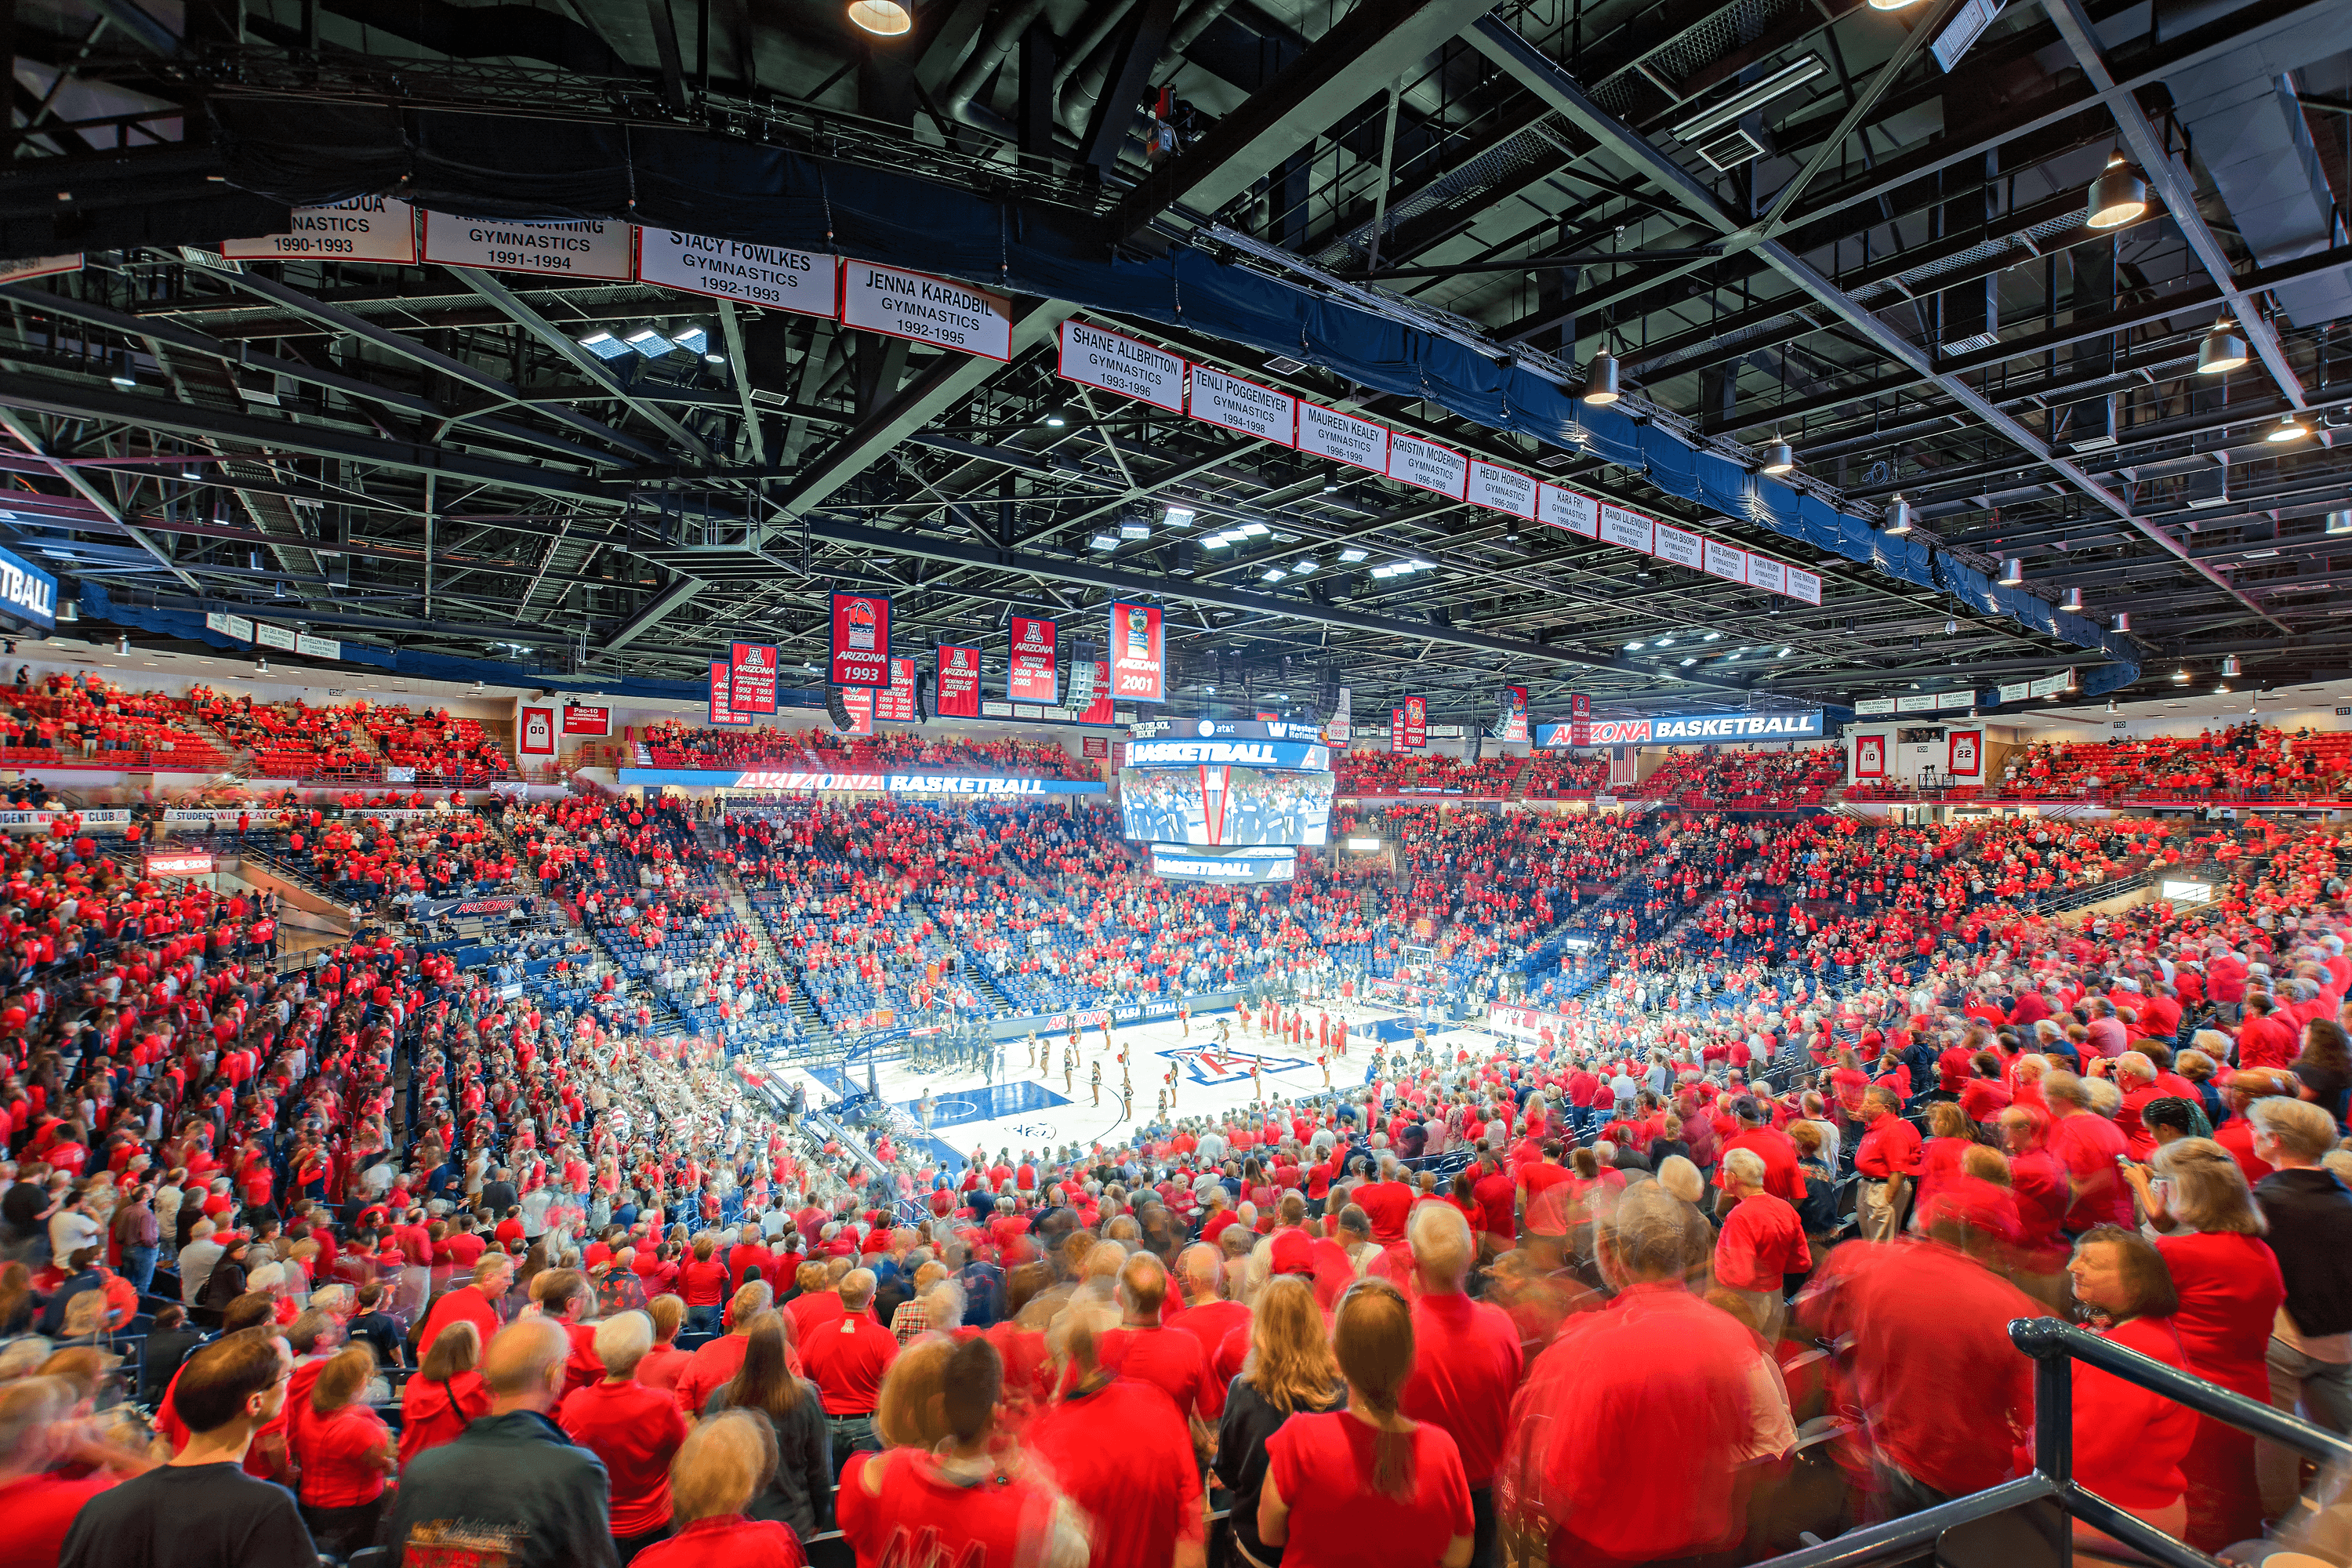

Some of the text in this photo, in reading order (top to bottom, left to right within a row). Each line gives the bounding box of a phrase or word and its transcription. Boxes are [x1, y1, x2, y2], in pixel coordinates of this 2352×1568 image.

[292, 216, 370, 233] NASTICS
[274, 238, 354, 253] 1990-1993
[469, 228, 590, 252] GYMNASTICS
[488, 250, 572, 269] 1991-1994
[731, 241, 811, 272] FOWLKES
[682, 253, 798, 288] GYMNASTICS
[700, 276, 780, 303] 1992-1993
[866, 270, 993, 318] JENNA KARADBIL
[880, 296, 980, 331] GYMNASTICS
[896, 318, 965, 345] 1992-1995
[1073, 327, 1178, 376] SHANE ALLBRITTON
[1089, 354, 1162, 386] GYMNASTICS
[1101, 372, 1151, 397] 1993-1996
[1196, 369, 1287, 413] TENLI POGGEMEYER
[1213, 395, 1275, 423] GYMNASTICS
[1222, 412, 1265, 434] 1994-1998
[1308, 408, 1380, 442] MAUREEN KEALEY
[1318, 429, 1371, 452] GYMNASTICS
[1392, 437, 1425, 457] KRISTIN
[1326, 445, 1363, 463] 1996-1999
[1408, 458, 1454, 480] GYMNASTICS
[1414, 473, 1446, 490] 1996-1999
[1479, 466, 1531, 492] HEIDI HORNBEEK
[1485, 483, 1525, 502] GYMNASTICS
[1557, 491, 1584, 510] KARA FRY
[1491, 496, 1519, 511] 1996-2000
[1552, 503, 1587, 521] GYMNASTICS
[1605, 507, 1650, 532] RANDI LILJENQUIST
[1611, 523, 1643, 539] GYMNASTICS
[1661, 527, 1697, 546] MONICA BISORDI
[1664, 540, 1693, 555] GYMNASTICS
[1722, 546, 1740, 561] JOHNSON
[1712, 556, 1738, 570] GYMNASTICS
[1755, 569, 1778, 582] GYMNASTICS
[0, 559, 53, 619] TBALL
[1794, 581, 1815, 593] GYMNASTICS
[322, 640, 336, 648] WHYTE
[1014, 642, 1054, 654] ARIZONA
[836, 651, 886, 663] ARIZONA
[1116, 658, 1160, 672] ARIZONA
[735, 665, 775, 675] ARIZONA
[844, 666, 879, 681] 1993
[941, 667, 978, 677] ARIZONA
[1014, 668, 1052, 679] 2000 2002
[891, 677, 913, 685] ZONA
[1013, 677, 1031, 687] 2005
[1120, 674, 1153, 691] 2001
[530, 726, 545, 735] 00
[1147, 720, 1171, 731] DEL SOL
[1216, 724, 1235, 734] at&t
[1289, 722, 1319, 734] Western
[1330, 729, 1346, 738] 1997
[1508, 729, 1523, 738] 2001
[1656, 715, 1815, 739] BASKETBALL
[1289, 731, 1319, 742] Refining
[1408, 735, 1422, 744] 1997
[1134, 743, 1278, 763] BASKETBALL
[1865, 753, 1875, 761] 10
[1957, 750, 1972, 758] 22
[733, 771, 1046, 795] ARIZONA BASKETBALL
[1, 813, 32, 823] DENT
[89, 812, 114, 822] CLUB
[176, 810, 213, 820] STUDENT
[216, 811, 267, 820] WILCAT
[187, 859, 212, 869] ZOO
[1158, 859, 1254, 877] BASKETBALL
[455, 899, 515, 914] ARIZONA
[1044, 1001, 1184, 1032] ARZONA BASETBALL
